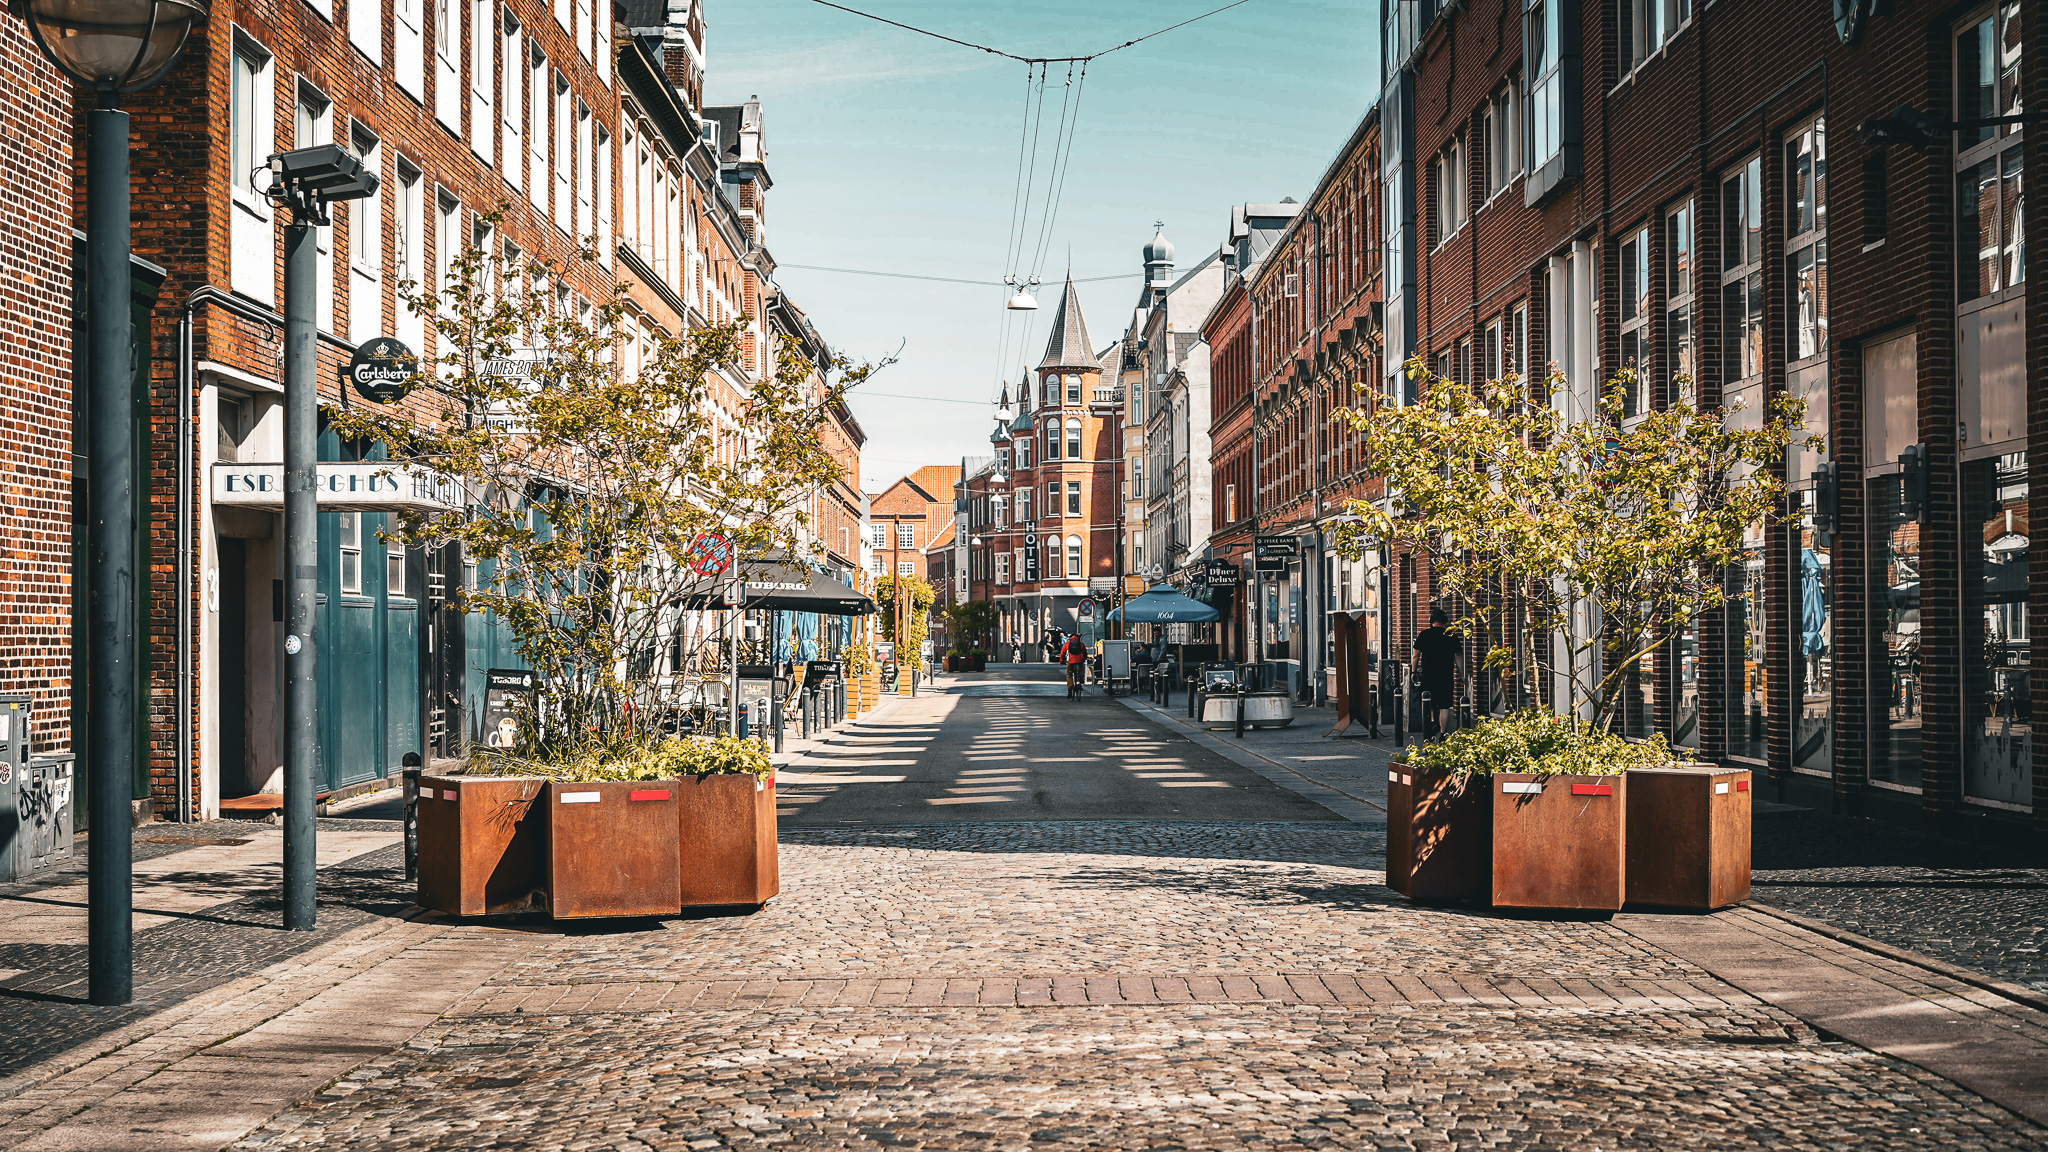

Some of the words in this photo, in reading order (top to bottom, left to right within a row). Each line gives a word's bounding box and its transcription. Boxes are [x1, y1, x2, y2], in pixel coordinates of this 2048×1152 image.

[482, 360, 516, 375] JAMES
[224, 474, 399, 492] ESBJRGHUS
[1025, 521, 1036, 581] HOTEL
[745, 581, 807, 591] TUBORG
[1208, 575, 1237, 583] Deluxe
